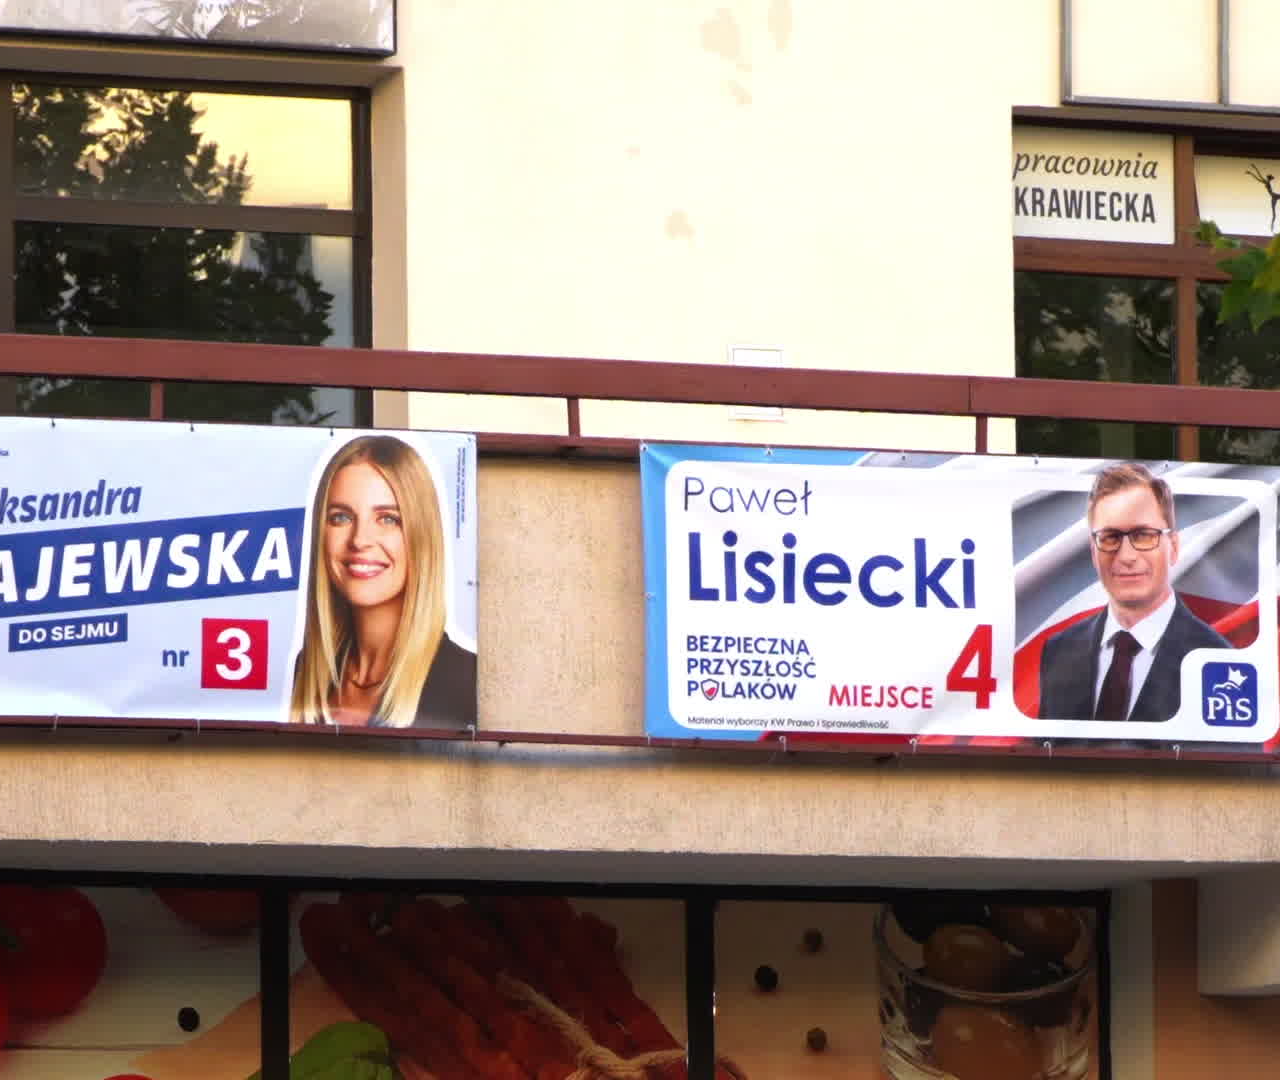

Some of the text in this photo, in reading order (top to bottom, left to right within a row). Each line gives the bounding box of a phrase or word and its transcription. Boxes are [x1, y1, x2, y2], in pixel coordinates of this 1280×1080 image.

[1013, 152, 1158, 181] pracownia
[1015, 186, 1156, 224] KRAWIECKA
[684, 476, 812, 515] Paweł
[687, 530, 976, 609] Lisiecki
[19, 621, 119, 643] DO SEJMU
[687, 635, 810, 656] BEZPIECZNA
[162, 628, 252, 680] nr 3
[687, 656, 817, 678] PRZYSZŁOŚĆ
[828, 624, 998, 710] MIEJSCE 4
